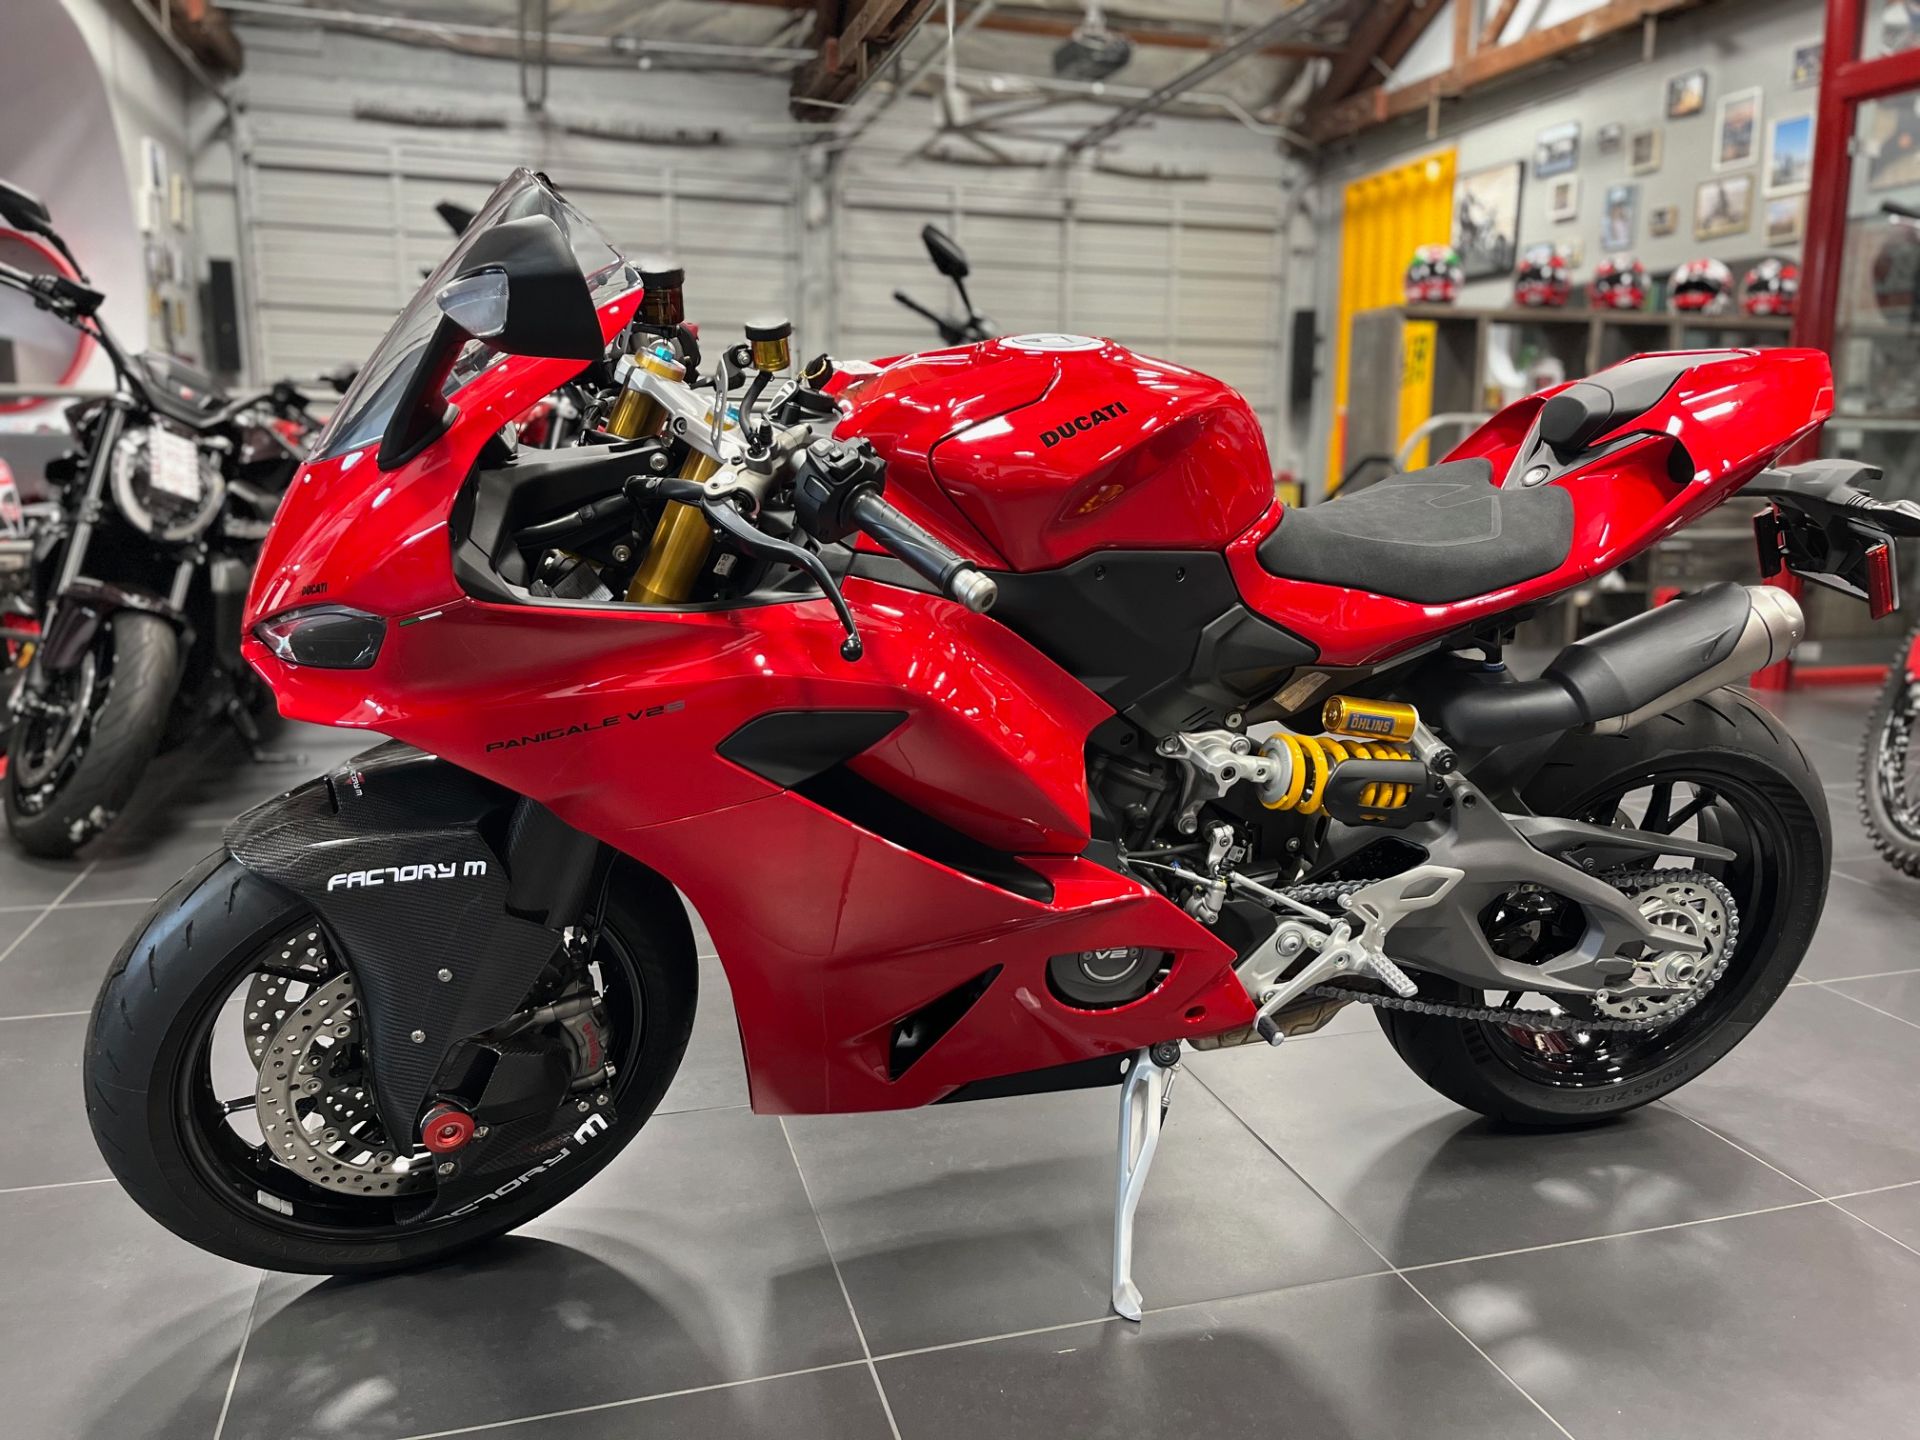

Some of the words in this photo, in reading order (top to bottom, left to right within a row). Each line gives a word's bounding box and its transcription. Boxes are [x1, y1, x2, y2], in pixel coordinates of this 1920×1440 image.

[1039, 401, 1129, 448] DUCATI
[301, 582, 328, 596] DUCATI
[486, 715, 621, 752] PANIGALE
[1350, 713, 1391, 732] ÖHLINS
[327, 862, 457, 892] FACTORY
[1095, 948, 1128, 960] V2
